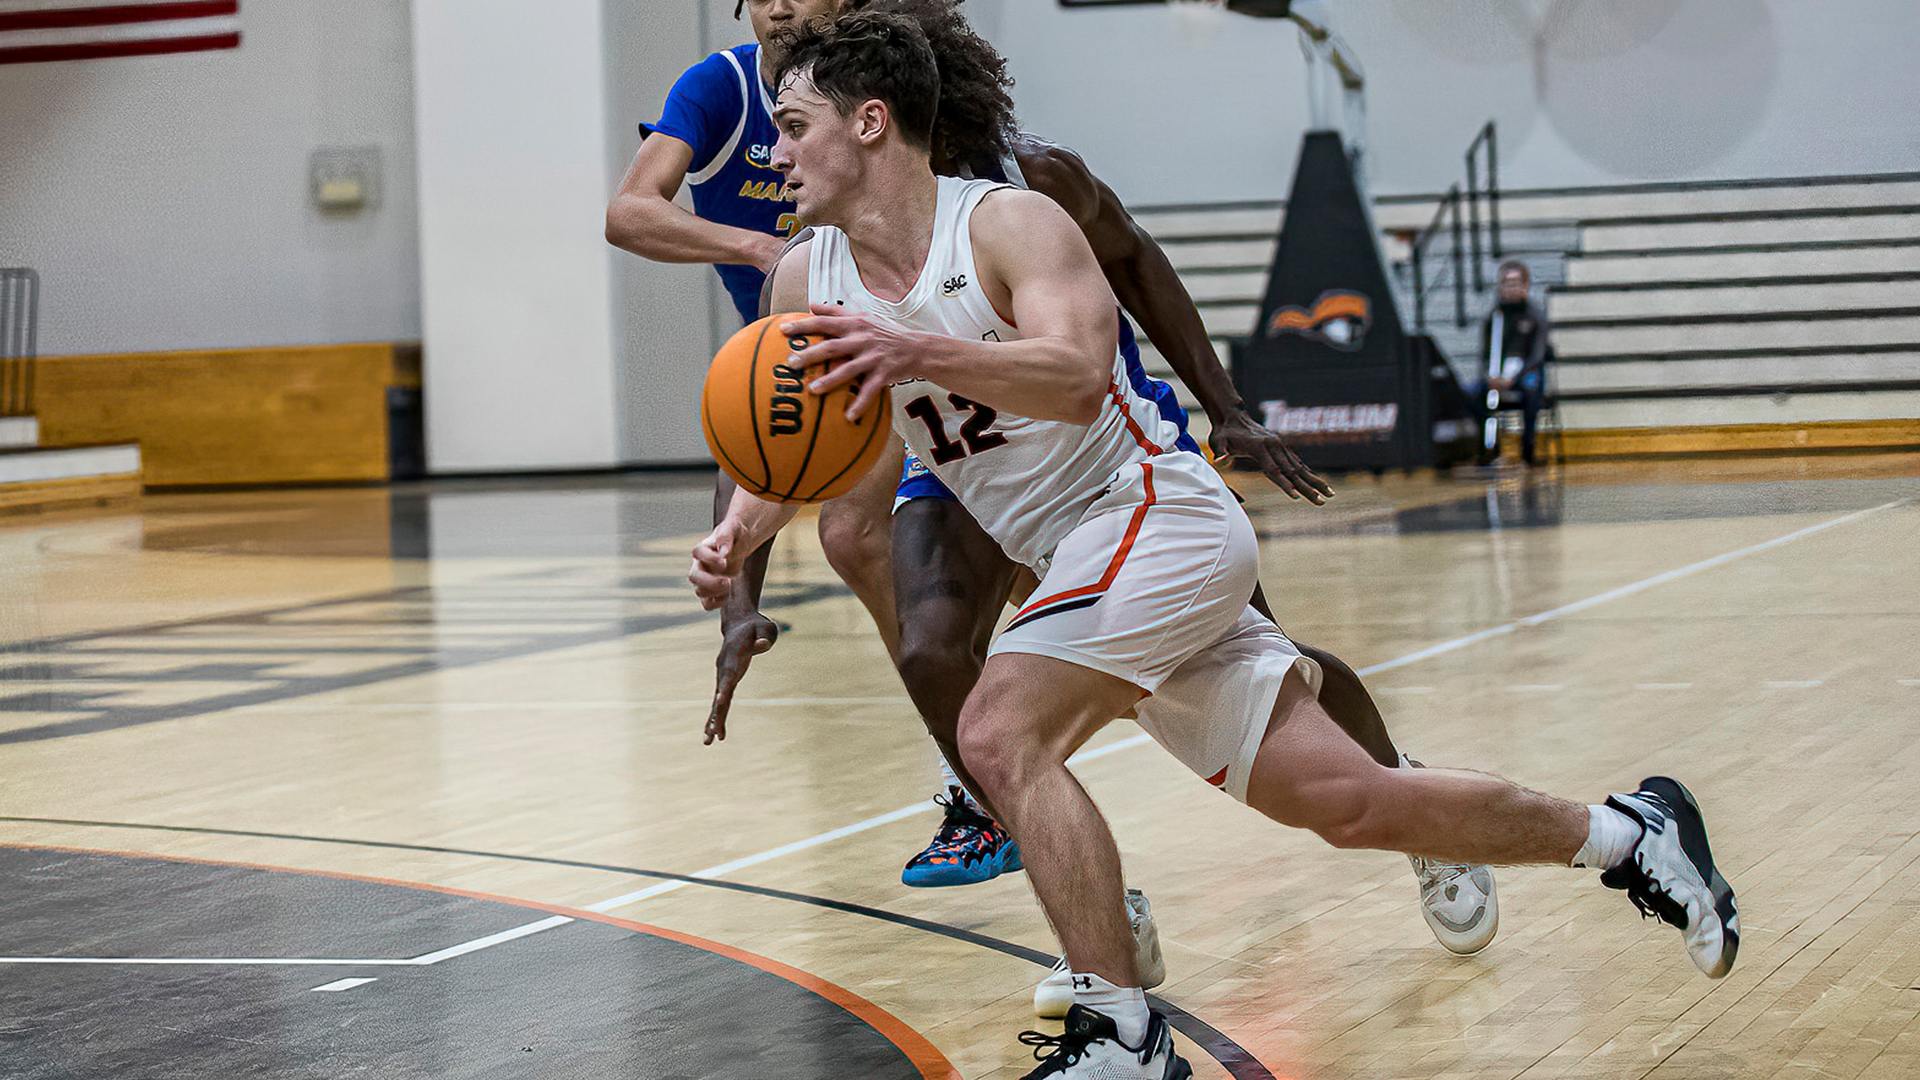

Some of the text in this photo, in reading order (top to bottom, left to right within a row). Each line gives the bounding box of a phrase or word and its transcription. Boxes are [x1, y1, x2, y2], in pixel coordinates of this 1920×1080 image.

[750, 144, 771, 159] SA
[943, 273, 968, 294] SAC
[904, 391, 1009, 467] 12
